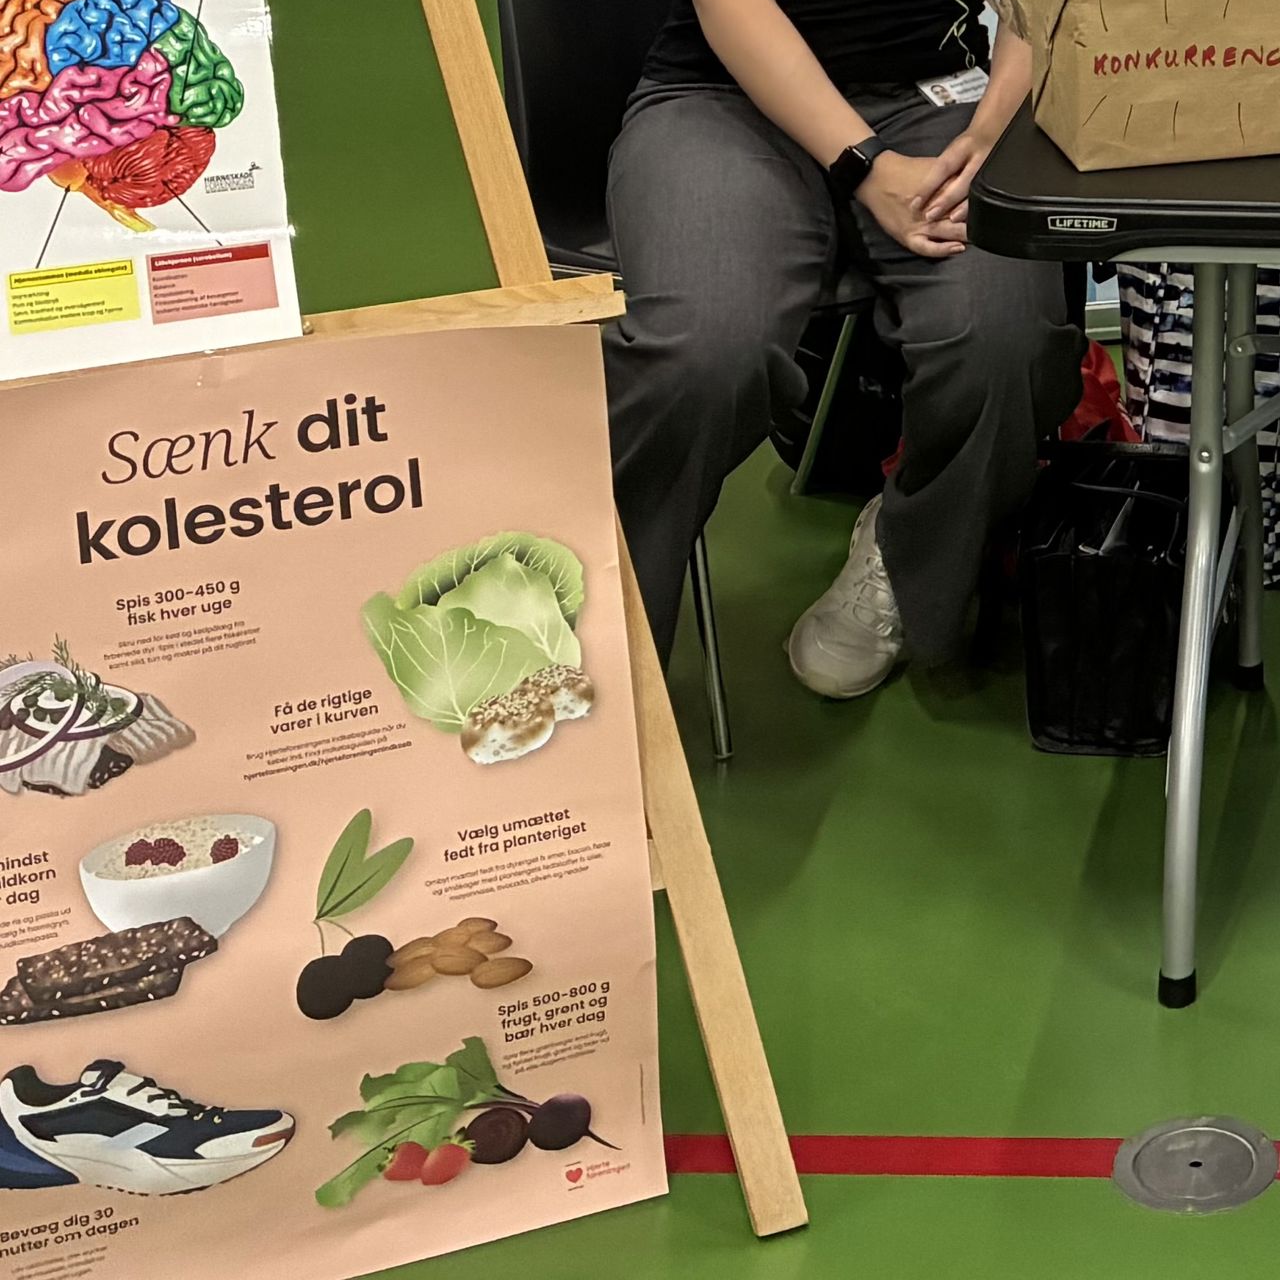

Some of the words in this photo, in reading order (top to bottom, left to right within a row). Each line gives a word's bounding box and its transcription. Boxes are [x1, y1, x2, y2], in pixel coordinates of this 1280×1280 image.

[1055, 218, 1109, 229] LIFETIME
[101, 409, 278, 484] Sænk
[297, 393, 389, 454] dit
[75, 457, 423, 565] kolesterol
[116, 595, 150, 613] Spis
[229, 580, 240, 594] g
[128, 611, 156, 626] fisk
[161, 604, 197, 621] hver
[201, 599, 232, 615] uge
[270, 717, 313, 734] varer
[317, 713, 321, 725] i
[325, 704, 379, 724] kurven
[274, 701, 293, 718] Få
[297, 699, 317, 712] de
[321, 689, 372, 709] rigtige
[457, 824, 499, 842] Vælg
[503, 808, 570, 833] umættet
[444, 846, 474, 862] fedt
[478, 841, 499, 855] fra
[503, 821, 587, 853] planteriget
[0, 869, 56, 889] ldkorn
[6, 889, 40, 905] dag
[498, 1000, 528, 1017] Spis
[600, 981, 610, 993] g
[501, 1012, 541, 1029] frugt,
[544, 1000, 585, 1020] grønt
[588, 996, 607, 1008] og
[505, 1027, 535, 1042] bær
[540, 1018, 572, 1034] hver
[576, 1010, 605, 1024] dag
[54, 1231, 81, 1245] om
[85, 1217, 139, 1236] dagen
[63, 1214, 90, 1227] dig
[94, 1207, 114, 1220] 30
